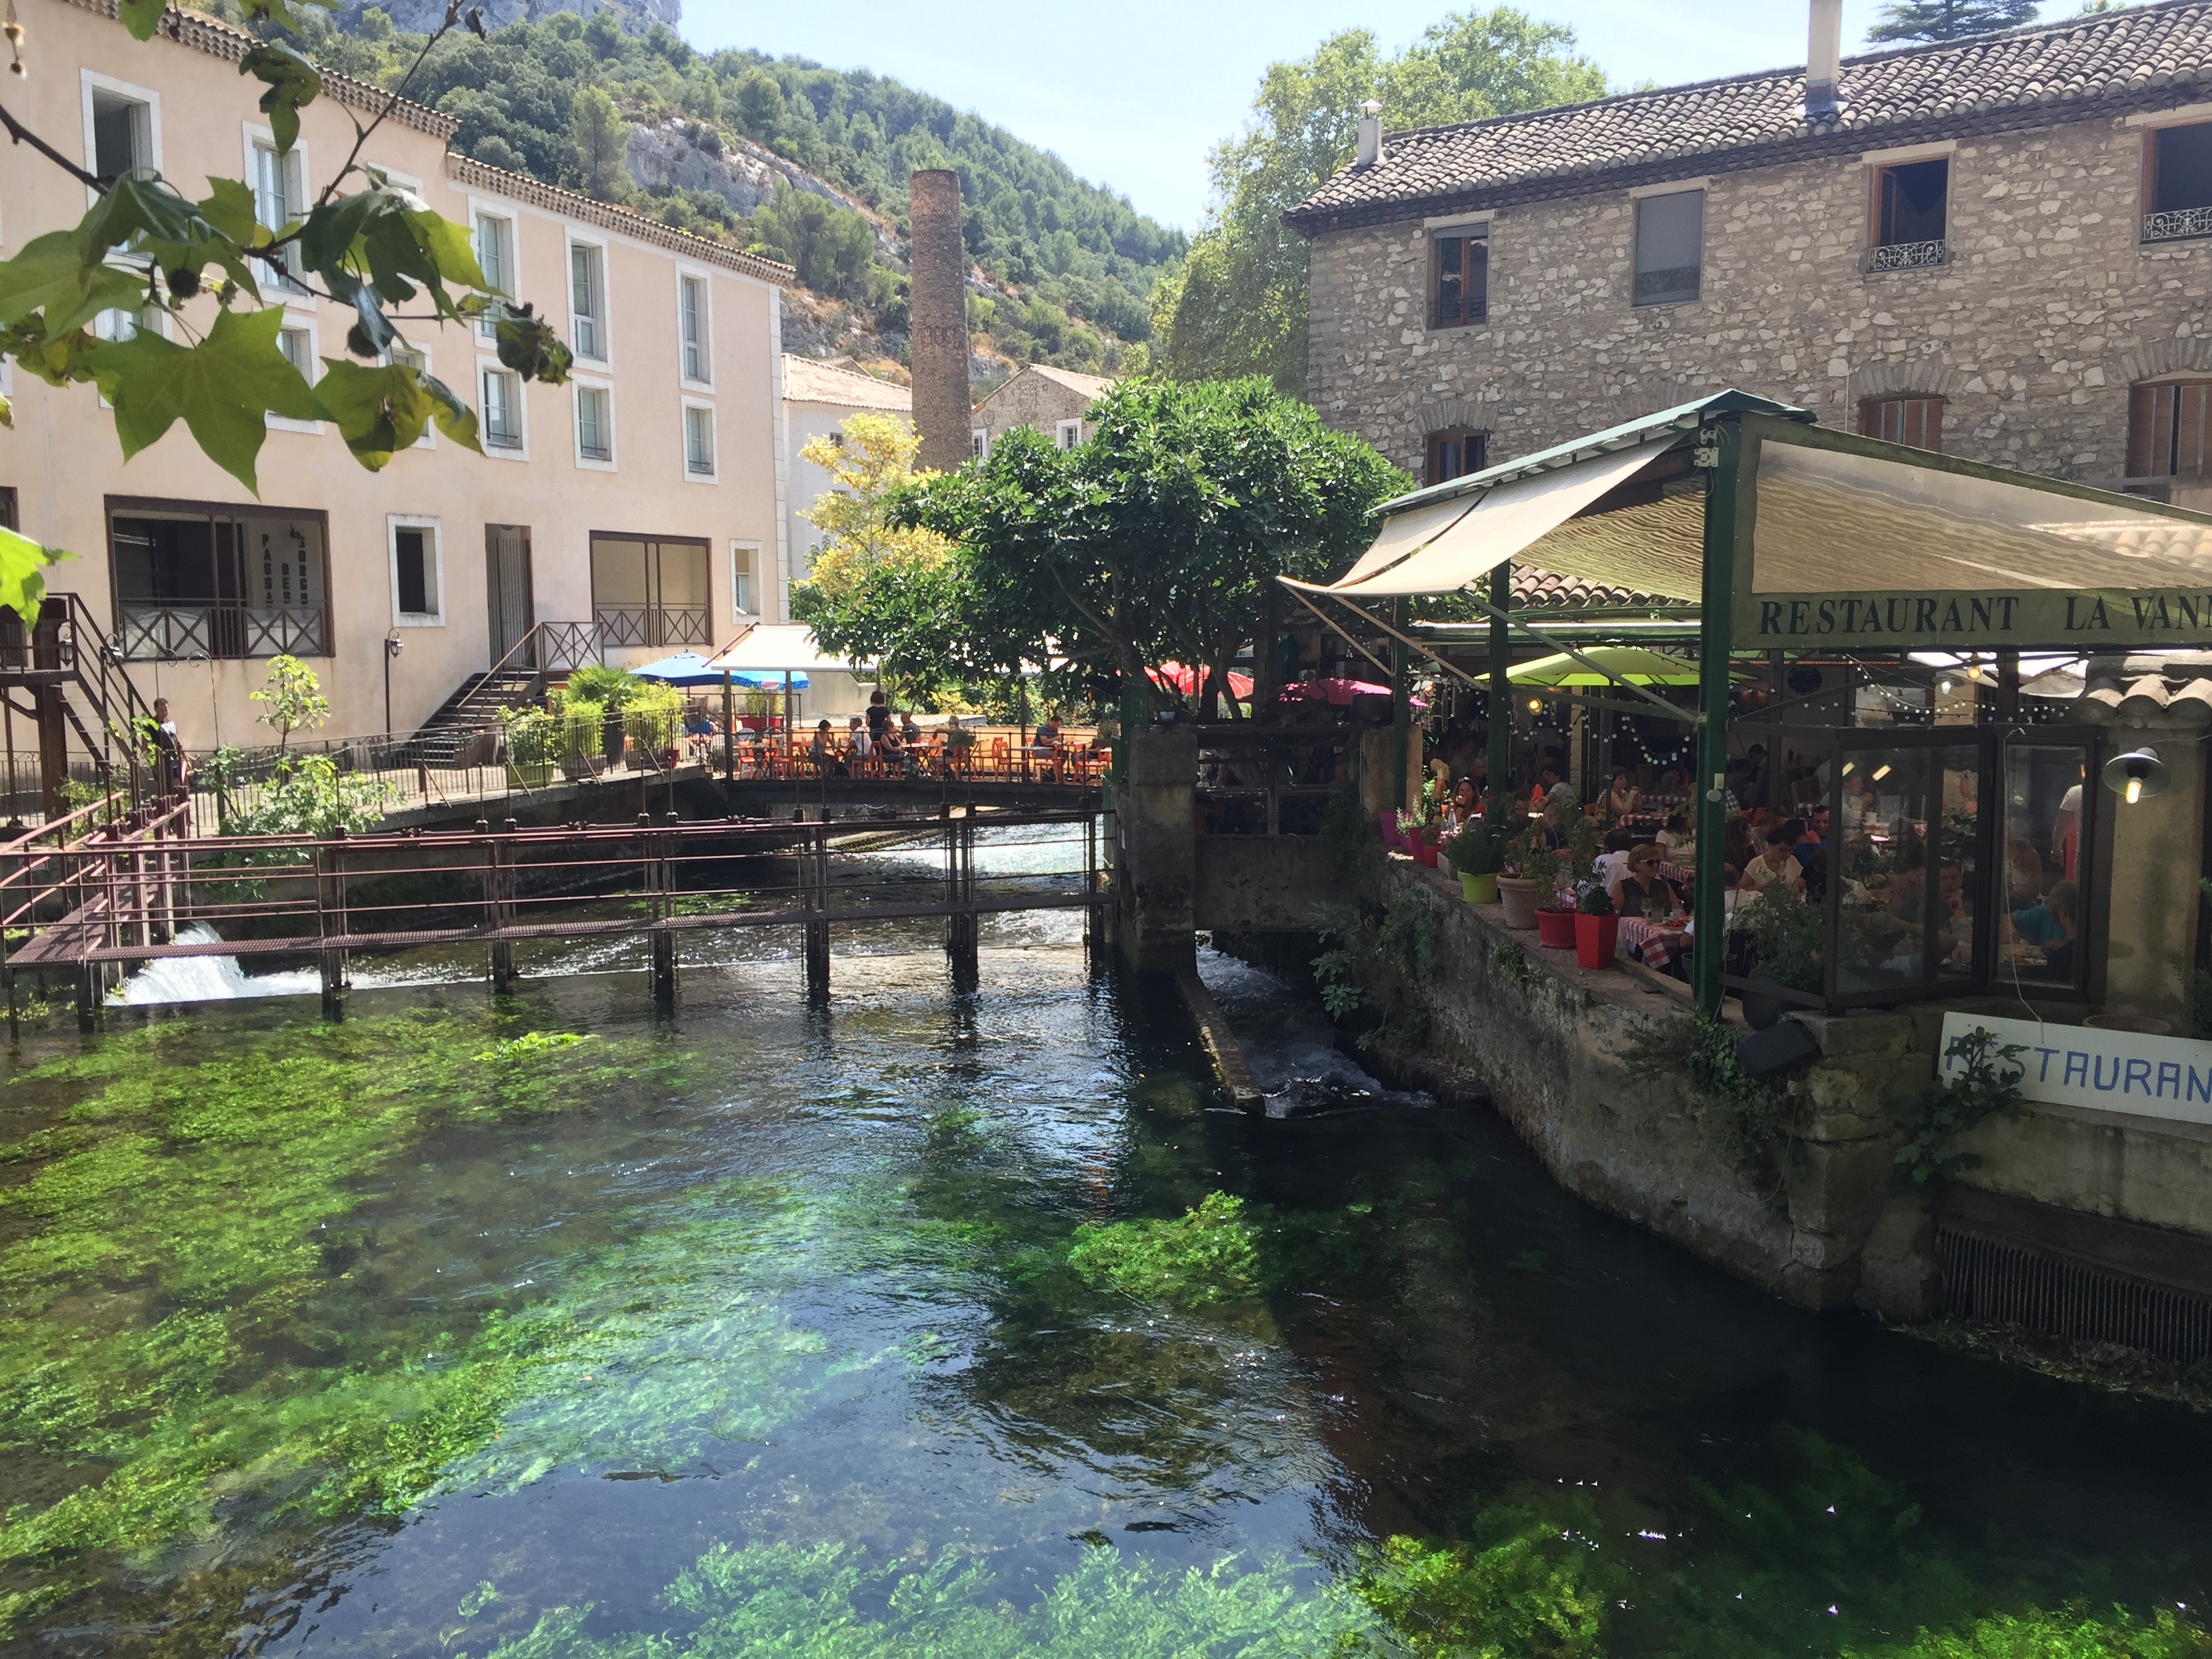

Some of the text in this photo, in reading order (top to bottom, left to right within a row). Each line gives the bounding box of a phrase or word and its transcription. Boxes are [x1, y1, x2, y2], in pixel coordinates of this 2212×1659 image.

[1759, 594, 2212, 636] RESTAURANT LA VAN
